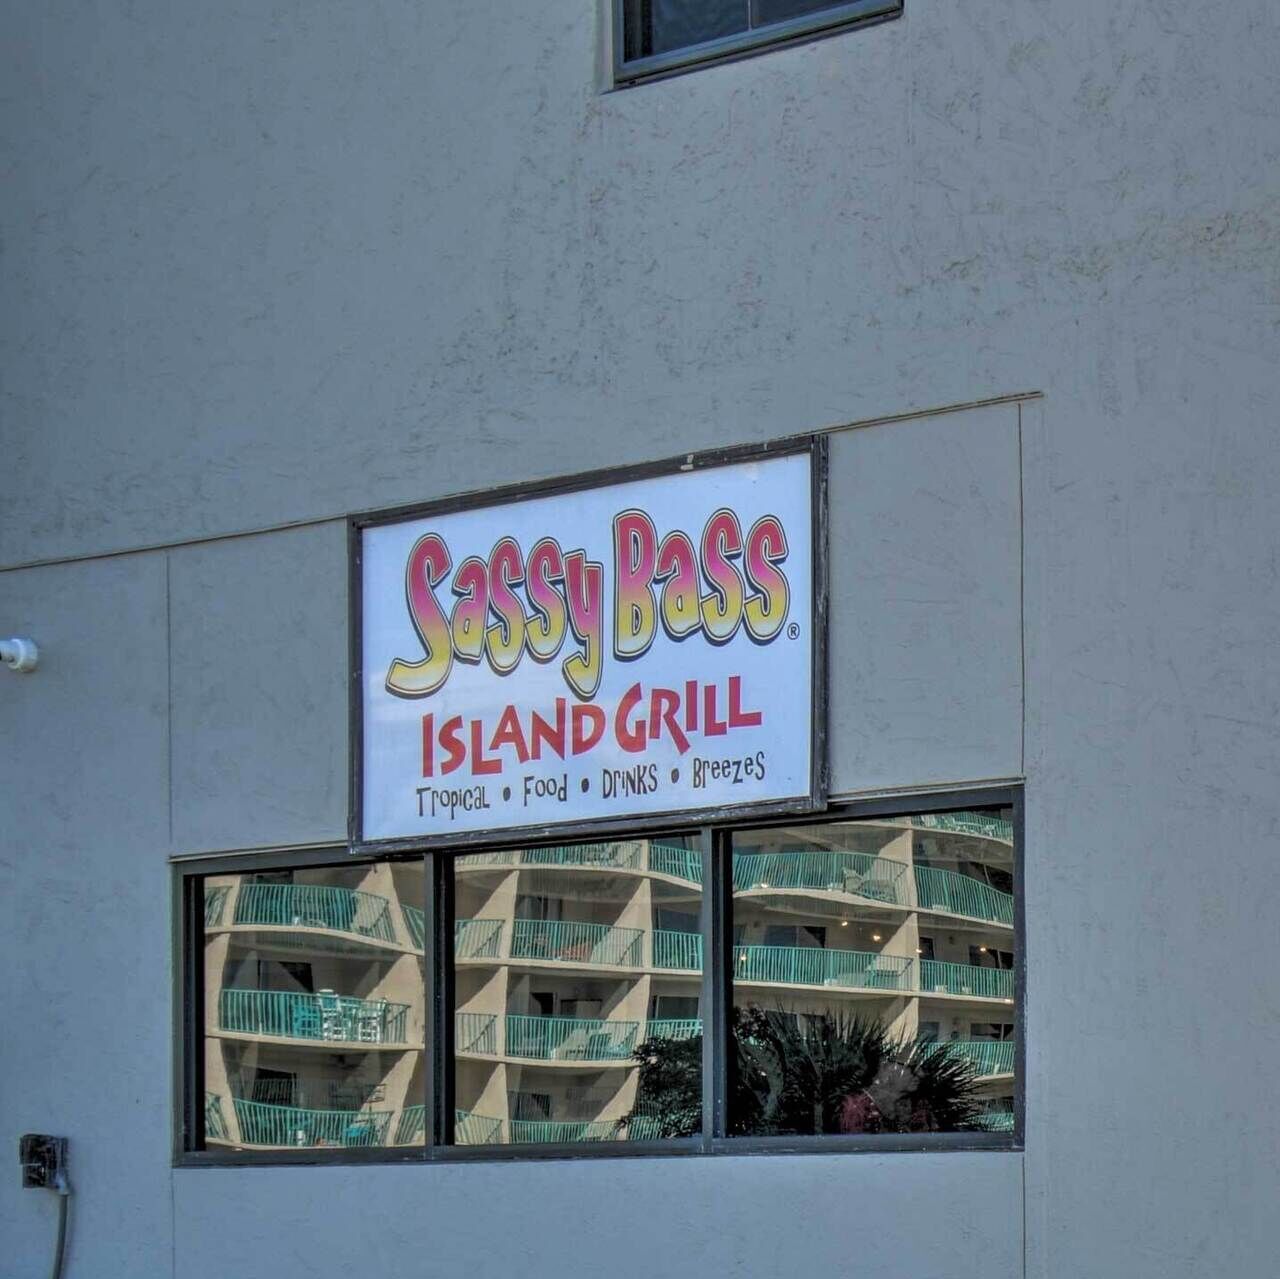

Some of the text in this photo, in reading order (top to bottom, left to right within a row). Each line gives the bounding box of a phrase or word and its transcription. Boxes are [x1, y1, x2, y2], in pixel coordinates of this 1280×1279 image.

[385, 532, 603, 699] Sassy
[613, 508, 790, 661] Bass
[422, 675, 762, 778] ISLAND GRILL
[523, 773, 568, 807] Food
